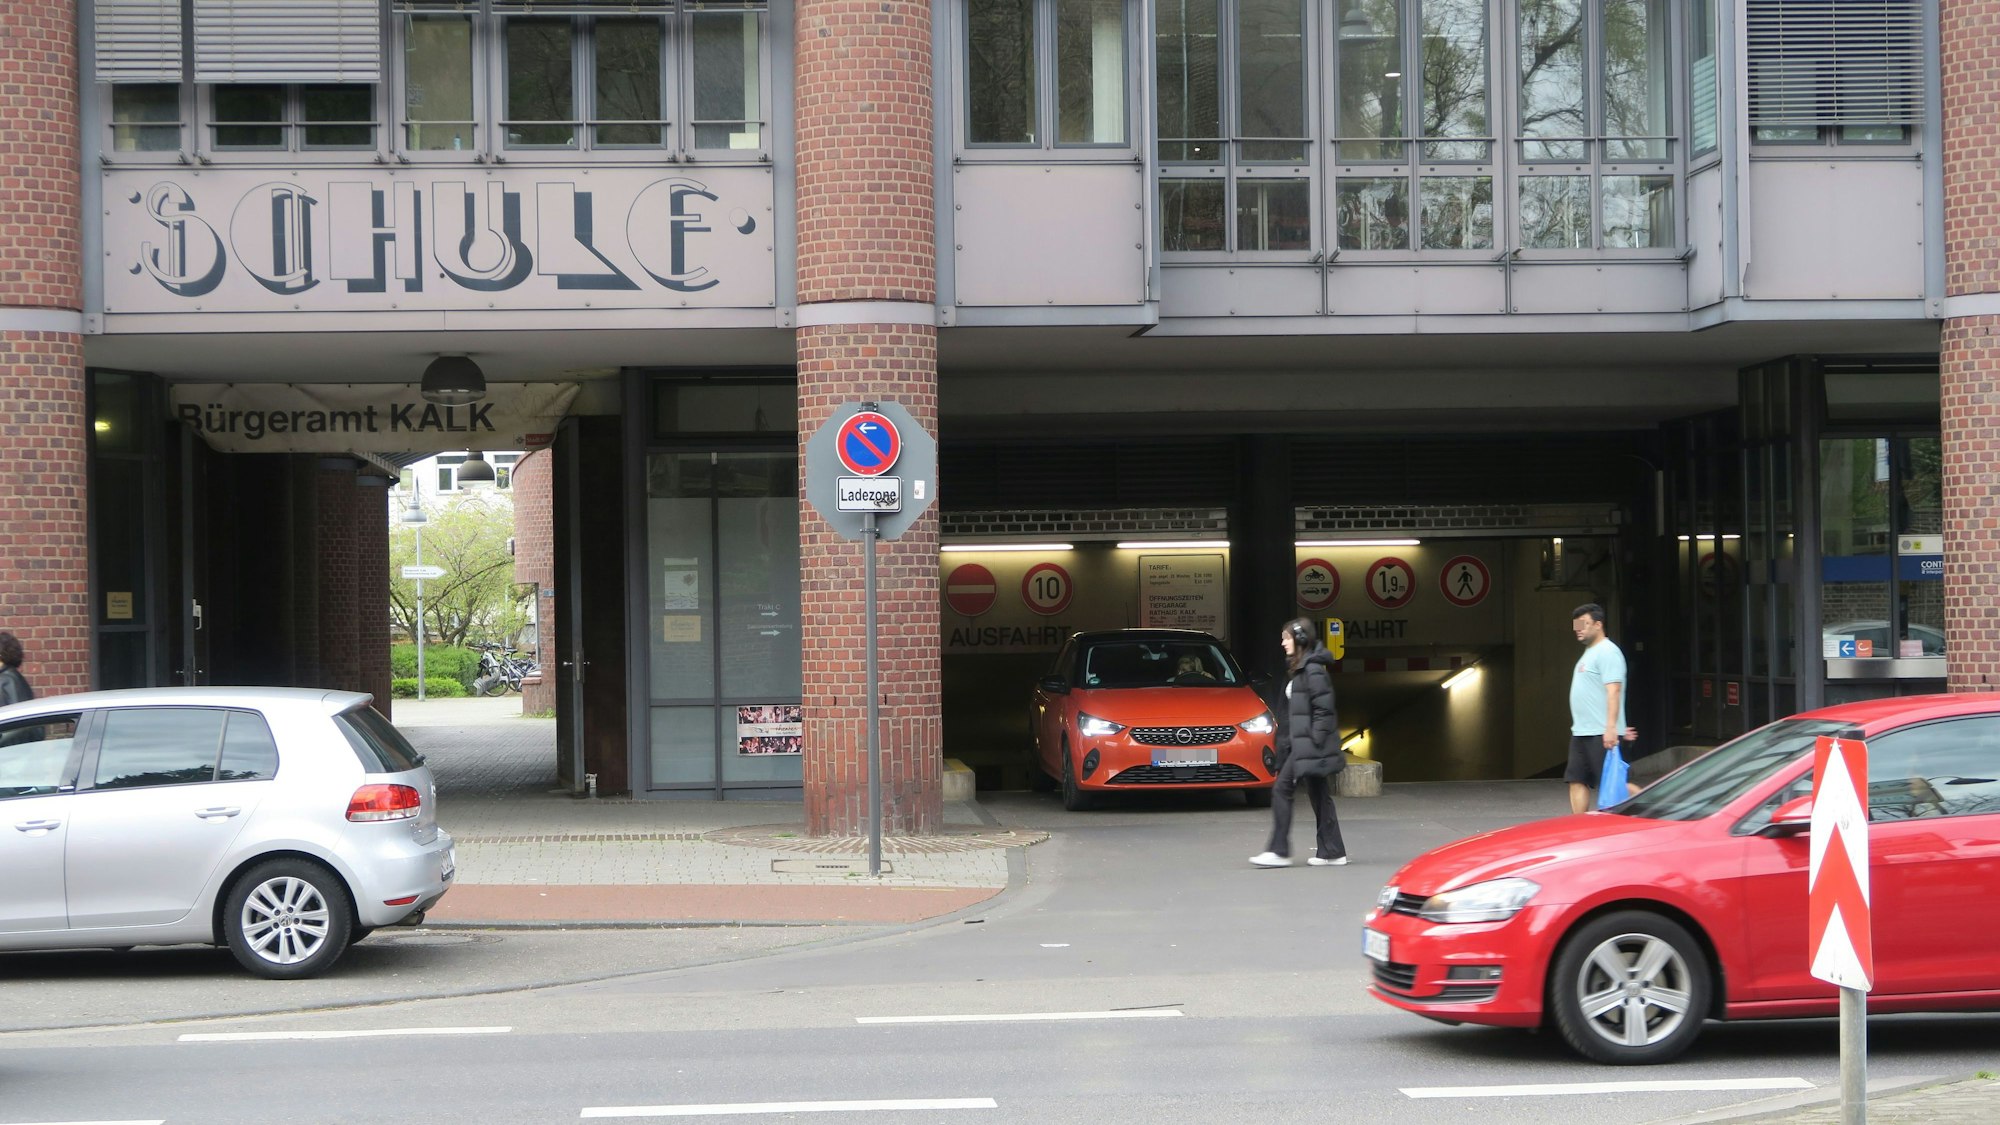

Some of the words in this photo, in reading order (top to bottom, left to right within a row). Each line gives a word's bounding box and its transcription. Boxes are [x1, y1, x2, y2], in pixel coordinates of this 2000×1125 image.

[140, 177, 720, 296] SCHULE
[177, 402, 378, 440] Bürgeramt
[390, 402, 497, 433] KALK
[840, 488, 897, 501] Ladezone
[1035, 576, 1060, 600] 10
[948, 626, 1072, 647] AUSFAHRT
